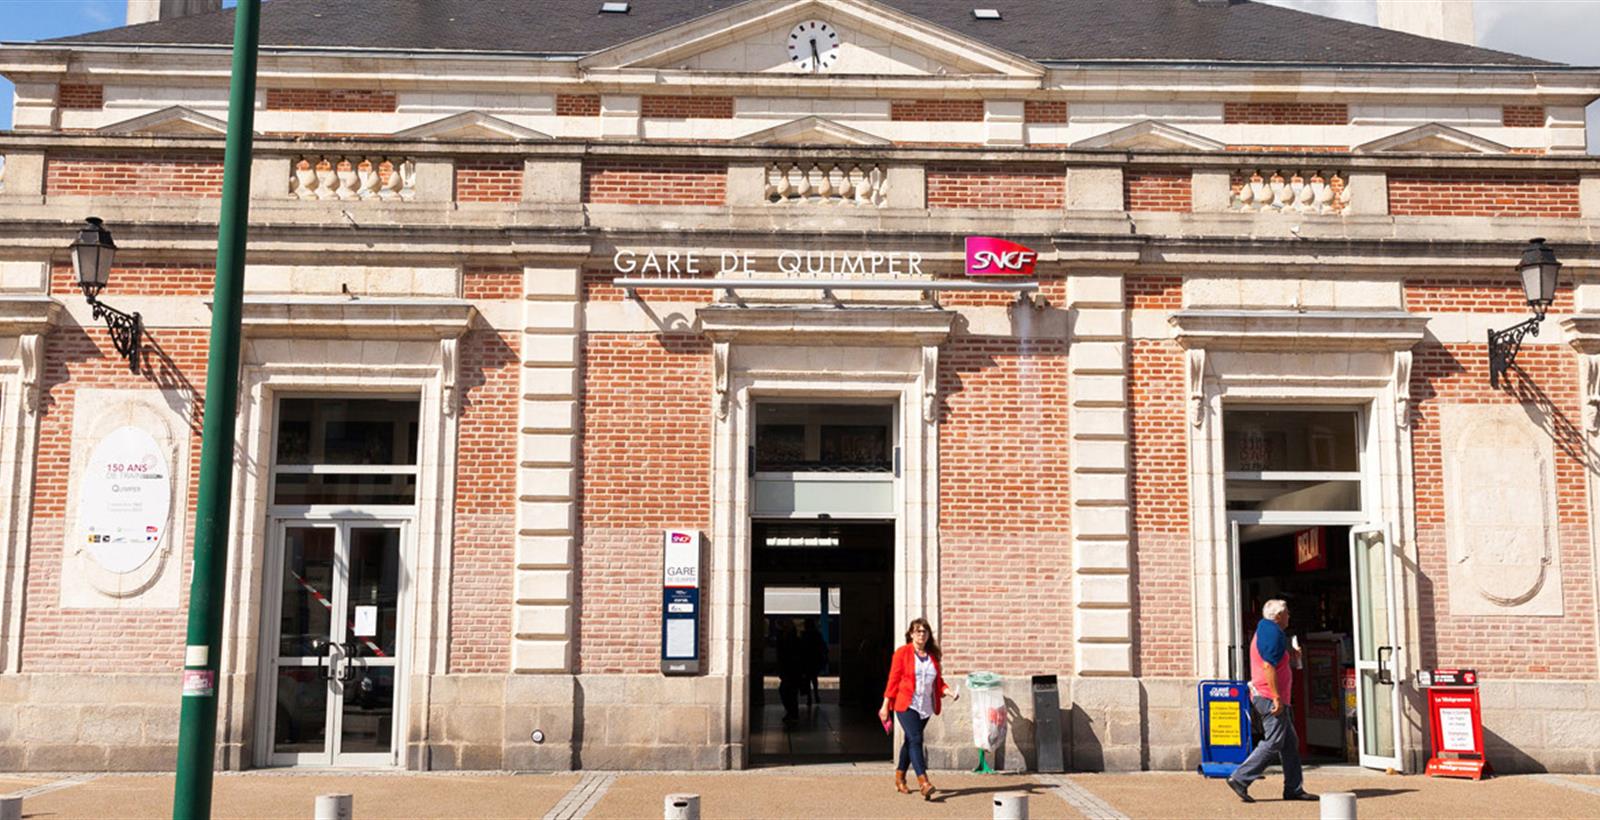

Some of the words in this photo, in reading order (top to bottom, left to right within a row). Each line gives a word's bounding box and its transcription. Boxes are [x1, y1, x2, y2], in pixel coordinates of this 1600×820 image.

[614, 249, 699, 273] GARE
[721, 250, 756, 273] DE
[777, 250, 923, 275] QUIMPER
[972, 250, 1035, 271] SNCF
[107, 463, 125, 472] 150
[127, 463, 148, 472] ANS
[667, 566, 696, 577] GARE
